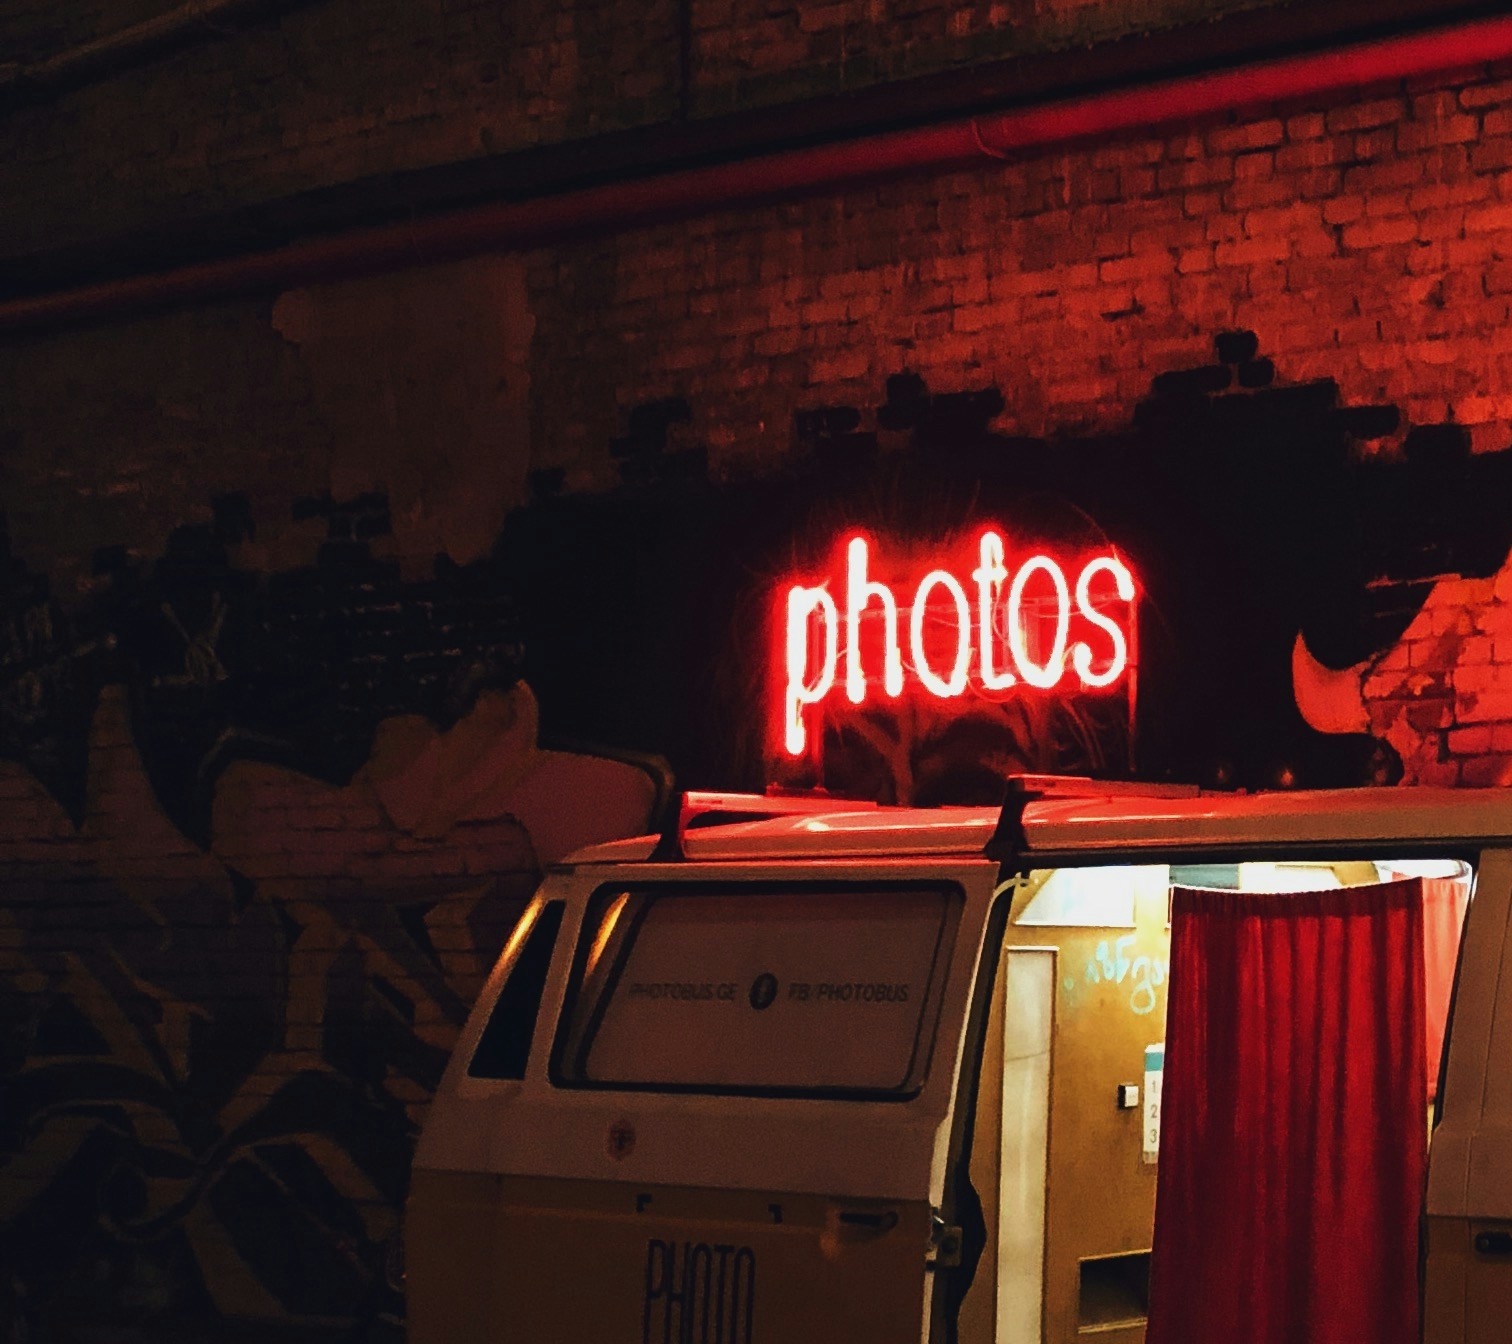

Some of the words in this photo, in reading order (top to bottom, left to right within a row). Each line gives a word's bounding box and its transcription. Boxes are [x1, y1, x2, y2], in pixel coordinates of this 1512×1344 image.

[786, 531, 1134, 755] photos
[1150, 1104, 1158, 1119] 2
[1149, 1129, 1158, 1143] 3
